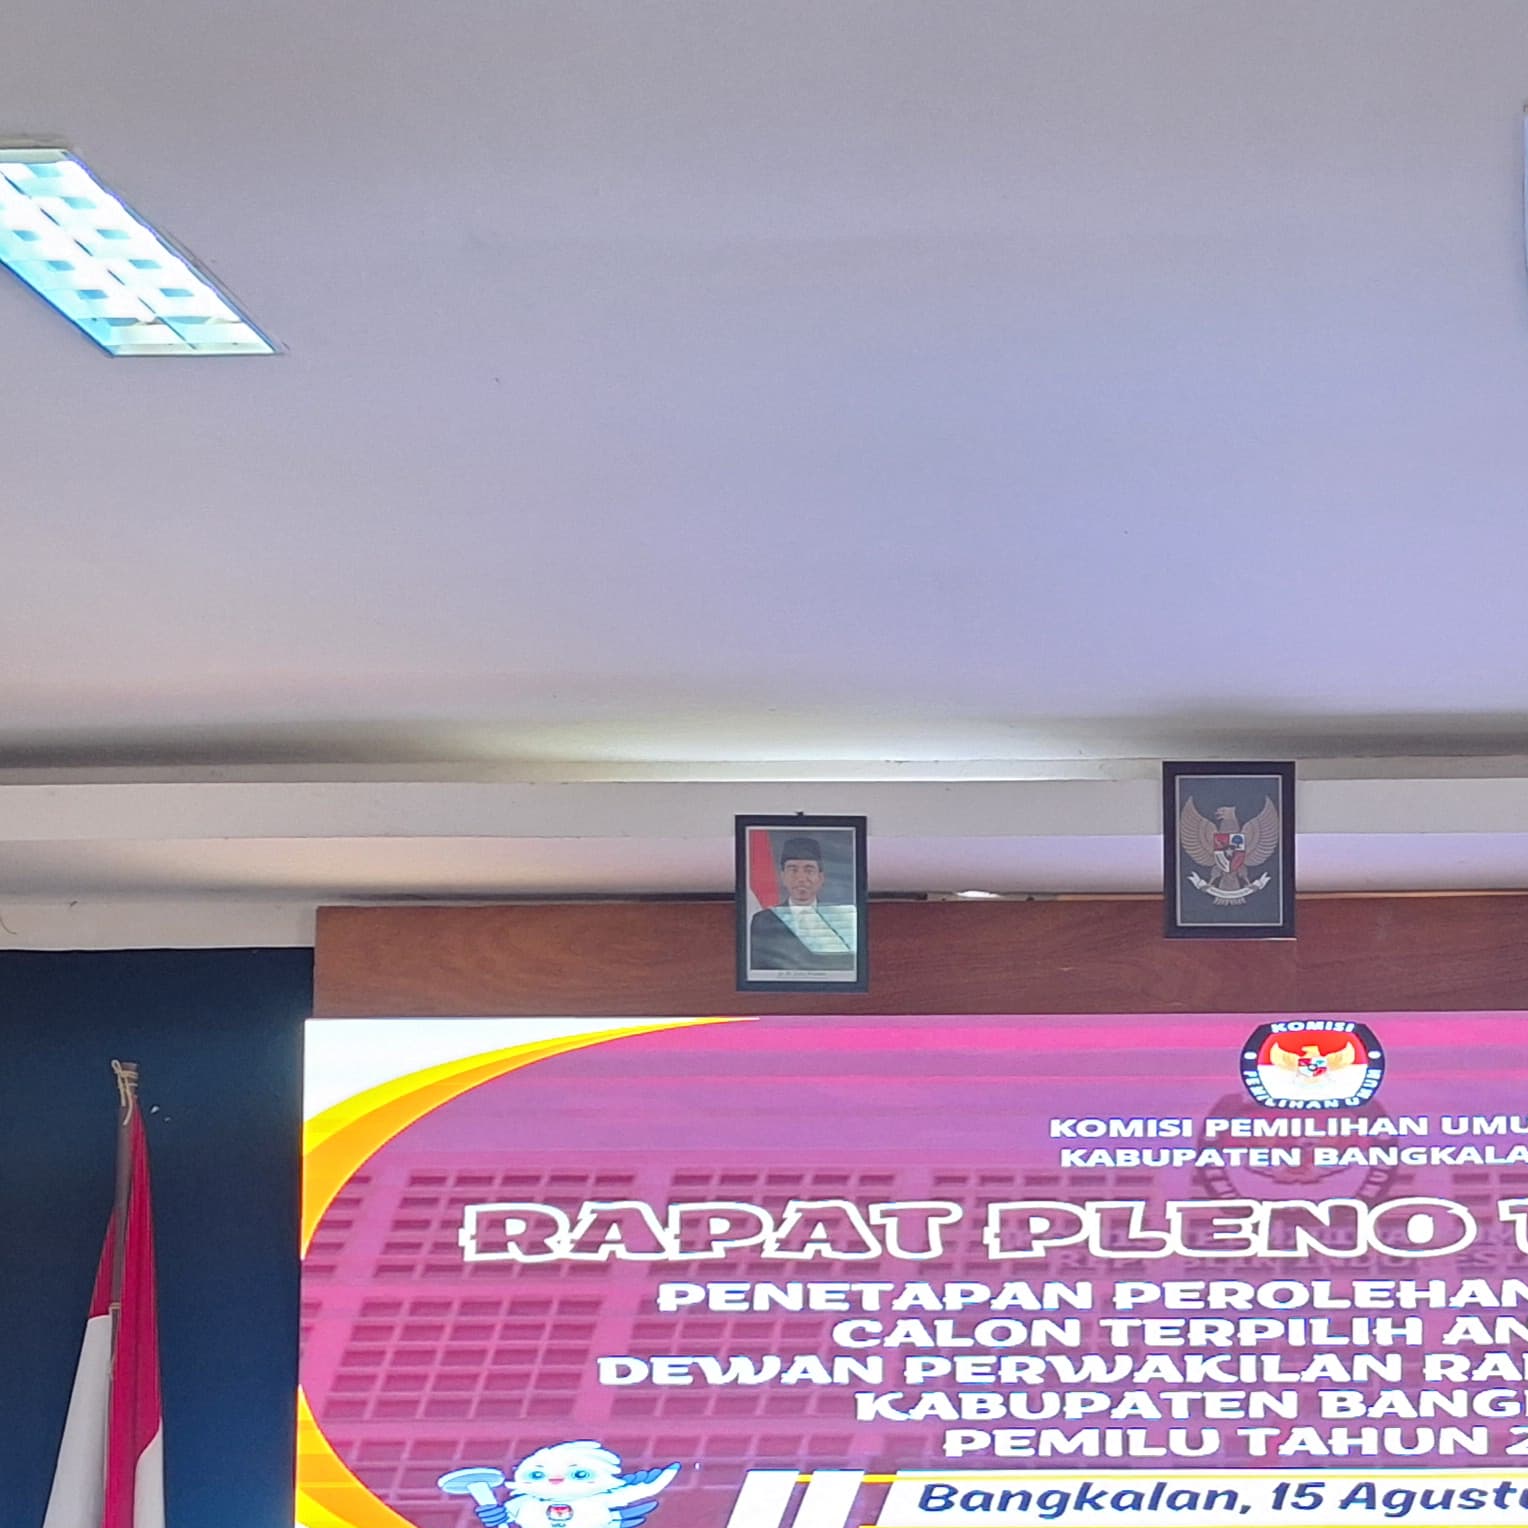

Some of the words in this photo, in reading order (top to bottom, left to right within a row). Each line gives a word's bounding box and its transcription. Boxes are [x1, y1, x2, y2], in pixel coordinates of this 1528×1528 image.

[1270, 1021, 1355, 1033] KOMISI
[1243, 1070, 1340, 1109] PEMILIHAN
[1345, 1069, 1382, 1106] UMUM
[1050, 1119, 1193, 1138] KOMISI
[1205, 1117, 1428, 1138] PEMILIHAN
[1061, 1148, 1301, 1168] KABUPATEN
[458, 1200, 962, 1264] RAPAT
[983, 1197, 1478, 1260] PLENO
[656, 1281, 1093, 1312] PENETAPAN
[832, 1318, 1081, 1349] CALON
[1099, 1317, 1423, 1347] TERPILIH
[597, 1355, 883, 1386] DEWAN
[903, 1353, 1402, 1385] PERWAKILAN
[855, 1390, 1298, 1421] KABUPATEN
[942, 1428, 1221, 1457] PEMILU
[1239, 1427, 1488, 1457] TAHUN
[918, 1482, 1252, 1520] Bangkalan,
[1271, 1482, 1325, 1510] 15
